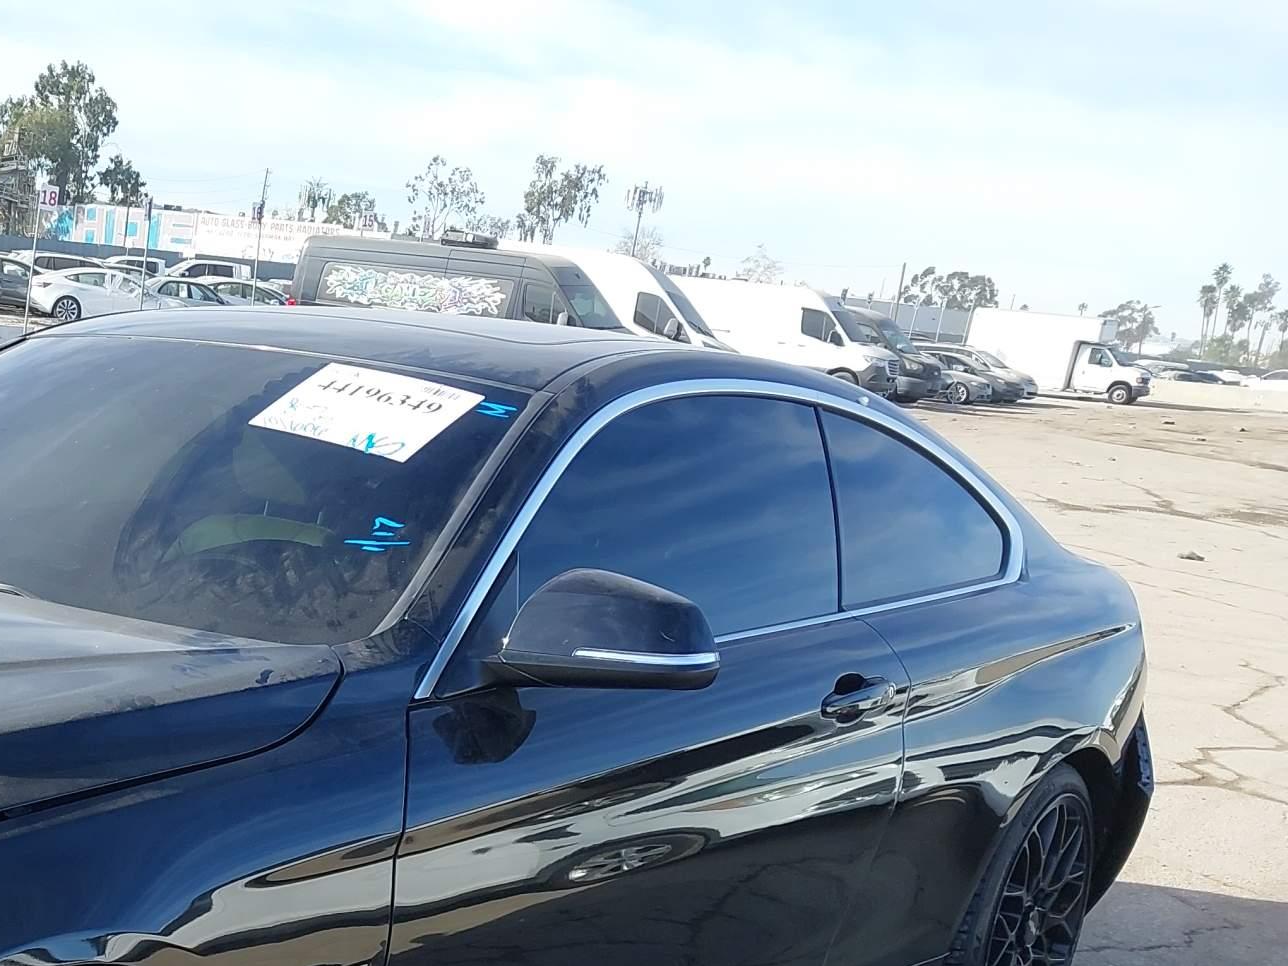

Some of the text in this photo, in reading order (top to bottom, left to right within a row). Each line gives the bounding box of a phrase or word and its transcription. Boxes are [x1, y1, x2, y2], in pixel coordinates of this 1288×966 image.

[40, 190, 57, 206] 18
[200, 216, 220, 227] AUTO
[270, 222, 293, 233] PARTS
[317, 379, 443, 415] 44196349
